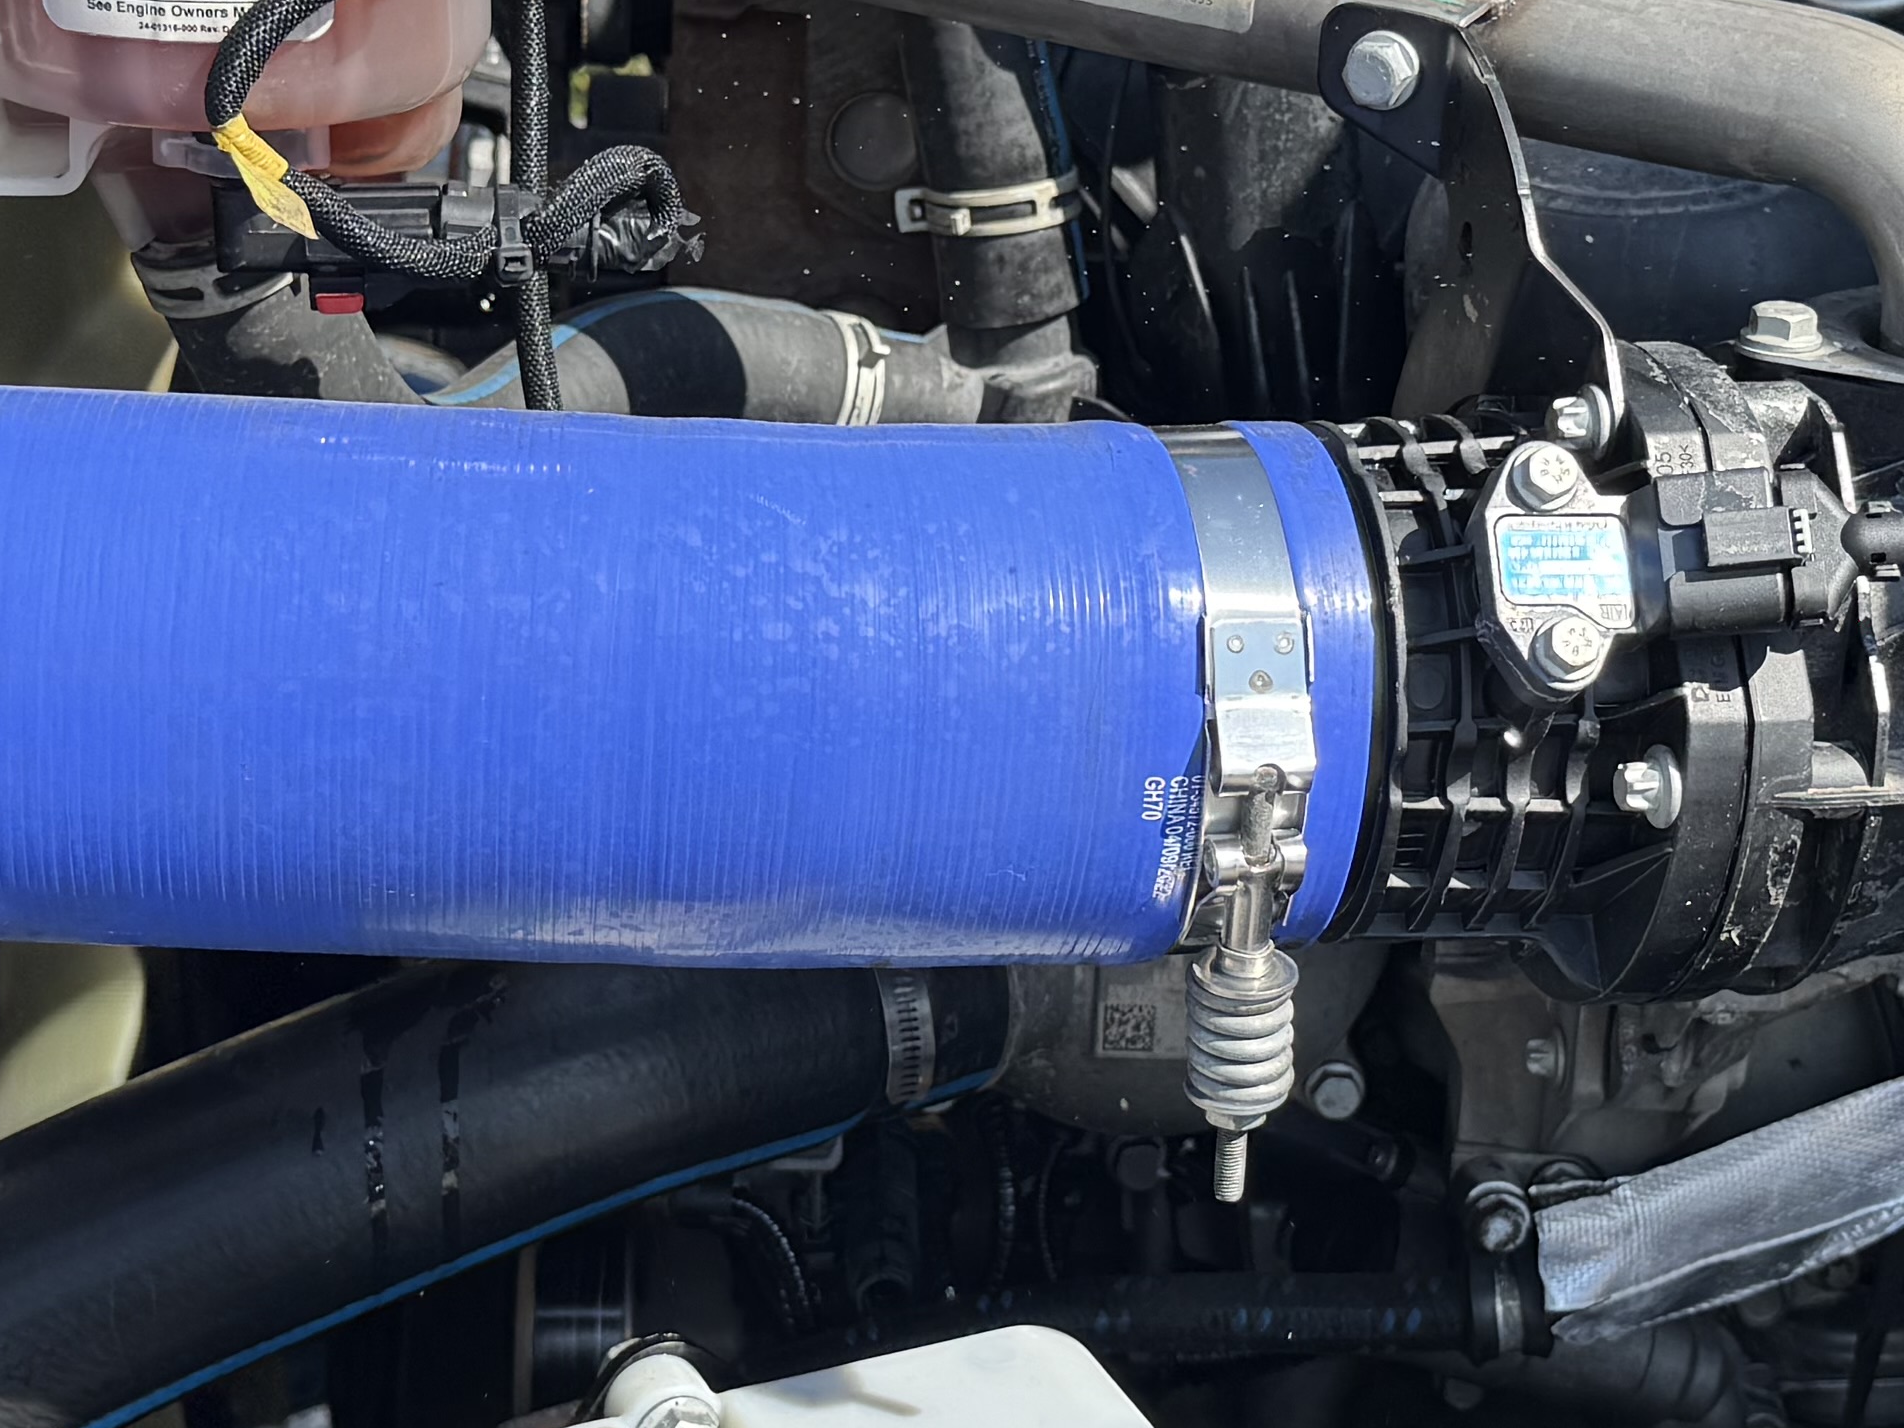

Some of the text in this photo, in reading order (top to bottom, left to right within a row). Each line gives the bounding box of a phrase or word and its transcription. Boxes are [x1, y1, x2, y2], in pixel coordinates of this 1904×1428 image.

[117, 1, 166, 19] Engine
[171, 4, 228, 19] Owners
[1141, 774, 1164, 821] GH70
[1165, 775, 1187, 824] CHINA
